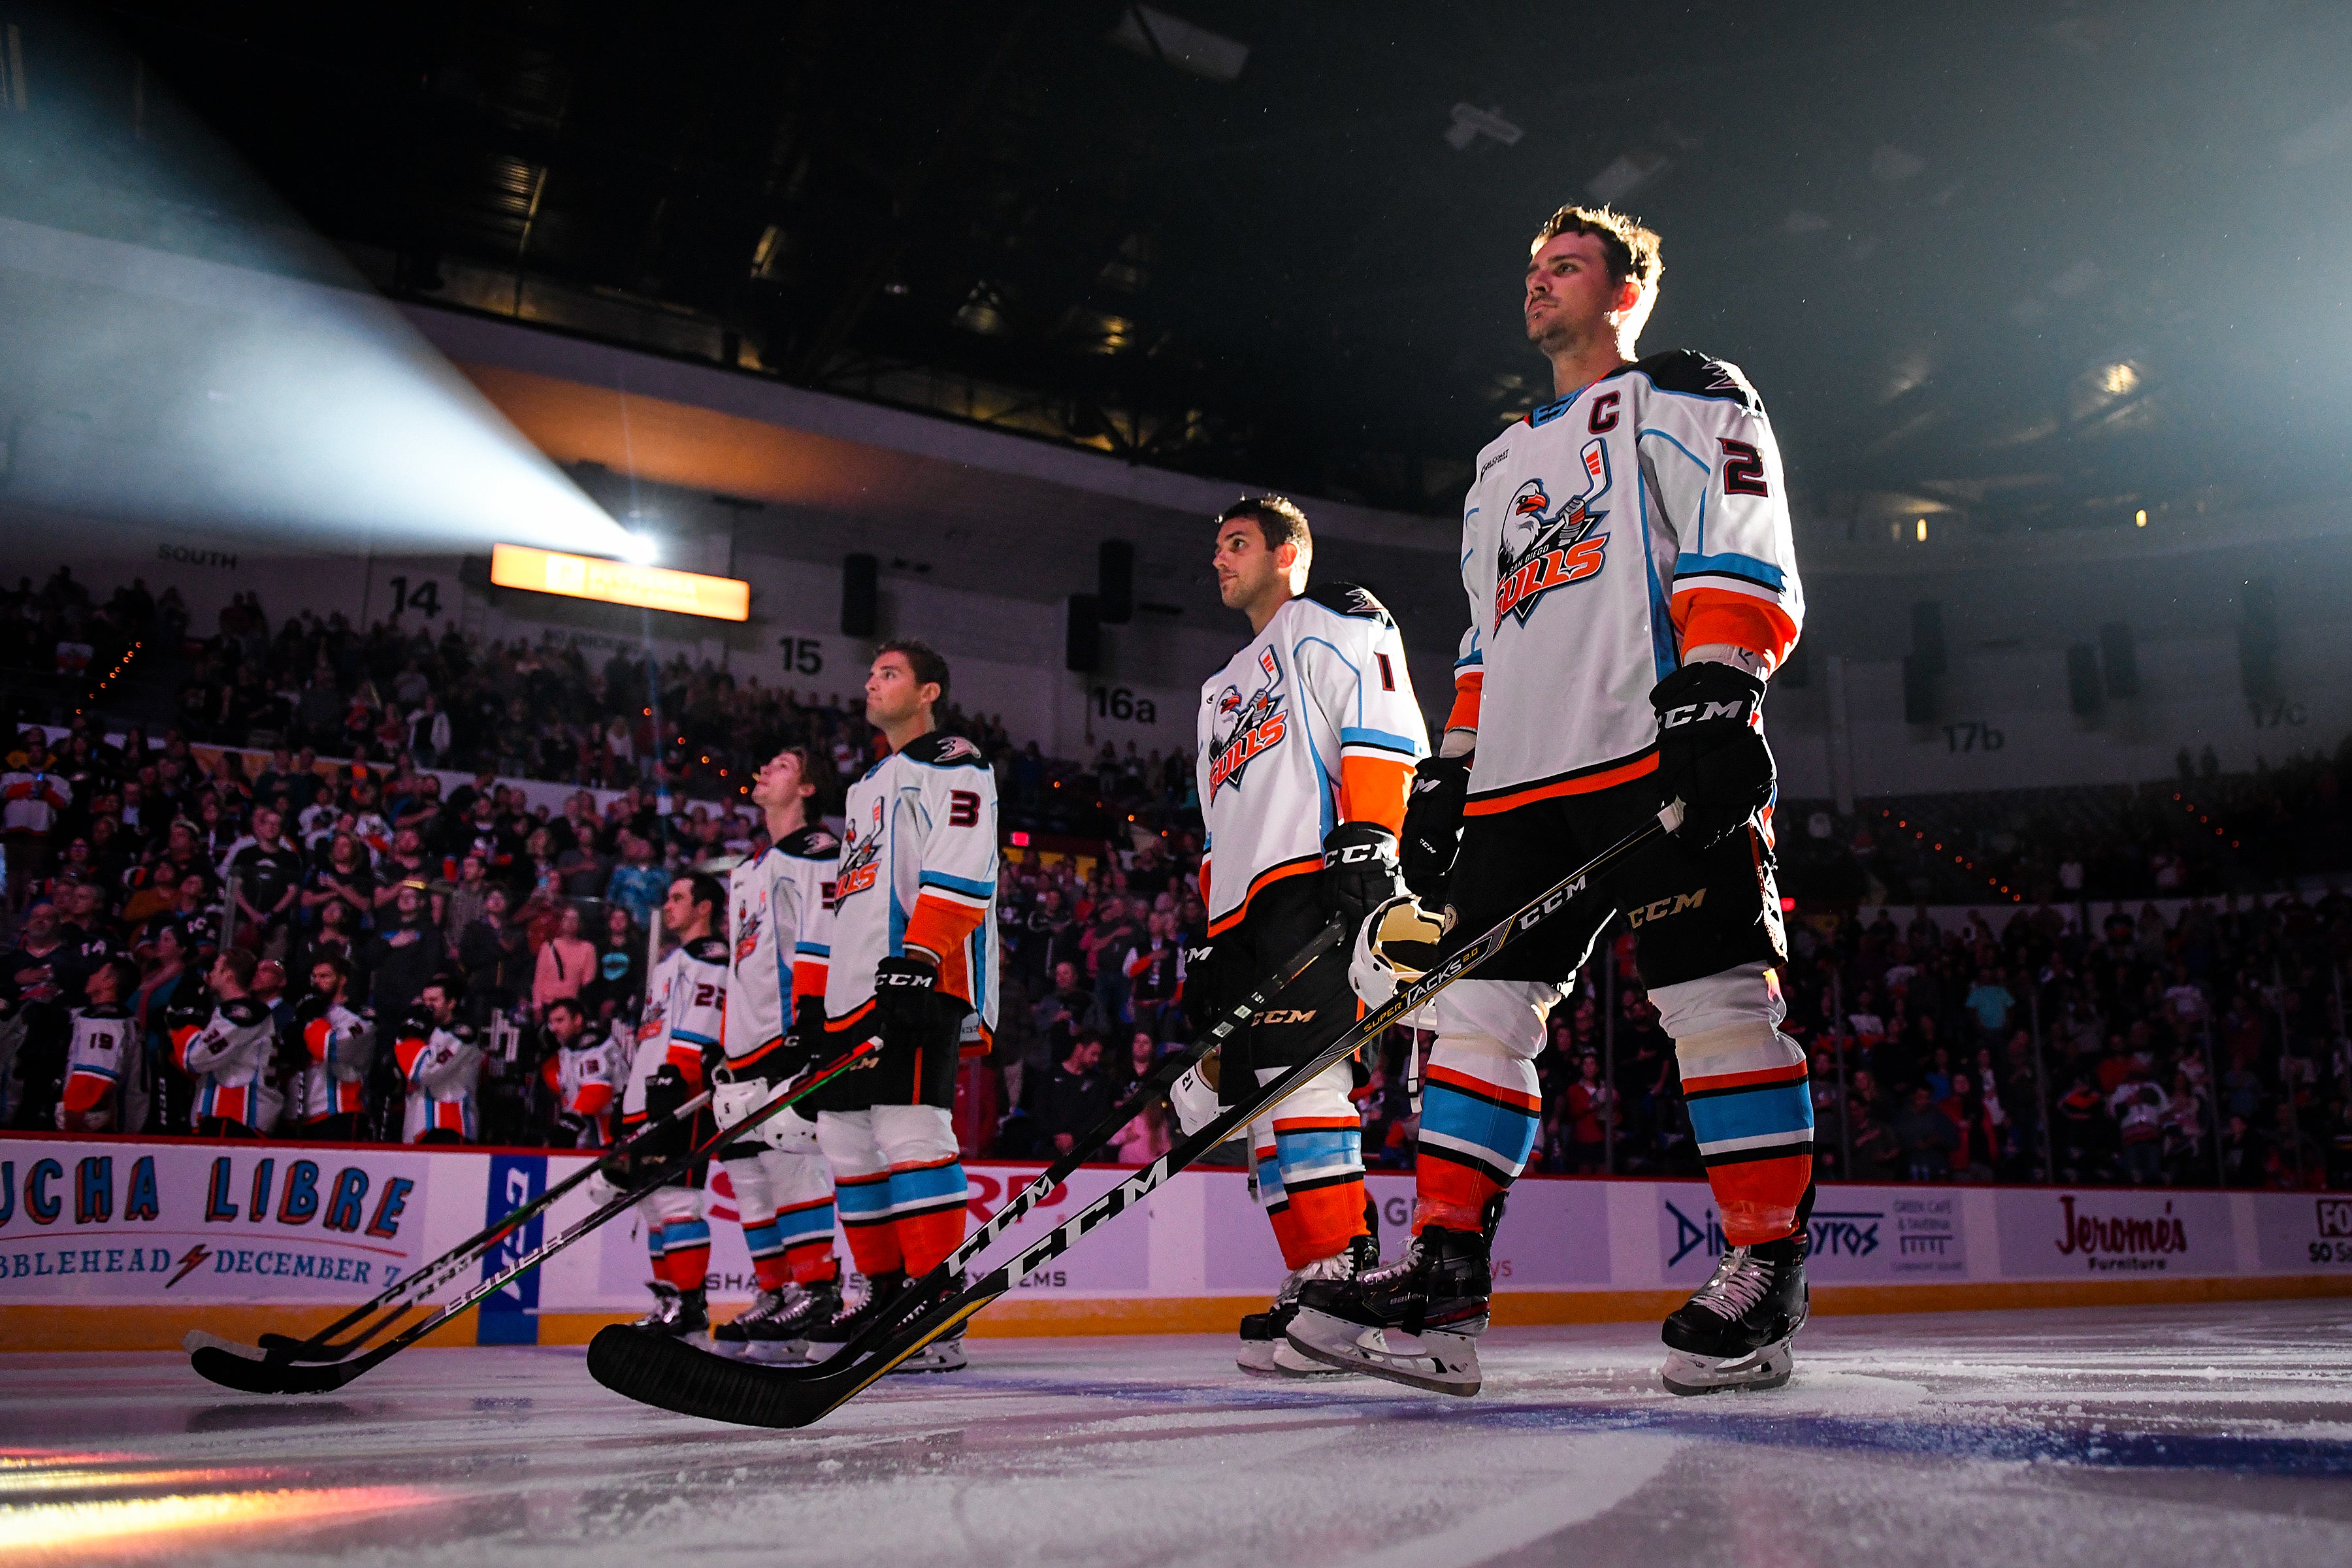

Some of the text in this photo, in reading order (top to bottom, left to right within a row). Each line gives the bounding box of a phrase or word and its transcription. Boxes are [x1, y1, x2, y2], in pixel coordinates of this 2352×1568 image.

[1589, 391, 1621, 434] C
[1718, 437, 1769, 497] 2
[157, 543, 237, 570] SOUTH
[1509, 544, 1550, 575] SAN DIEGO
[390, 576, 442, 618] 14
[1494, 534, 1609, 632] GULLS
[778, 636, 823, 676] 15
[1093, 687, 1156, 723] 16a
[1658, 700, 1743, 730] CM
[1942, 720, 2005, 751] 17b
[1209, 711, 1287, 802] GULLS
[949, 789, 981, 827] 3
[836, 862, 879, 900] LLS
[1519, 874, 1586, 931] CCM
[1627, 888, 1707, 929] CCM
[875, 973, 933, 988] CCM
[1364, 947, 1478, 1033] SUPER TACKS 2.0
[1251, 1009, 1317, 1027] CCM
[204, 1156, 414, 1239] LIBRE
[943, 1174, 1055, 1277] CCM
[1001, 1155, 1168, 1288] CCM
[2055, 1195, 2187, 1255] Jerome's
[214, 1249, 371, 1284] DECEMBER
[382, 1265, 402, 1288] 7
[706, 1273, 760, 1291] SHA
[2088, 1256, 2167, 1272] Furniture
